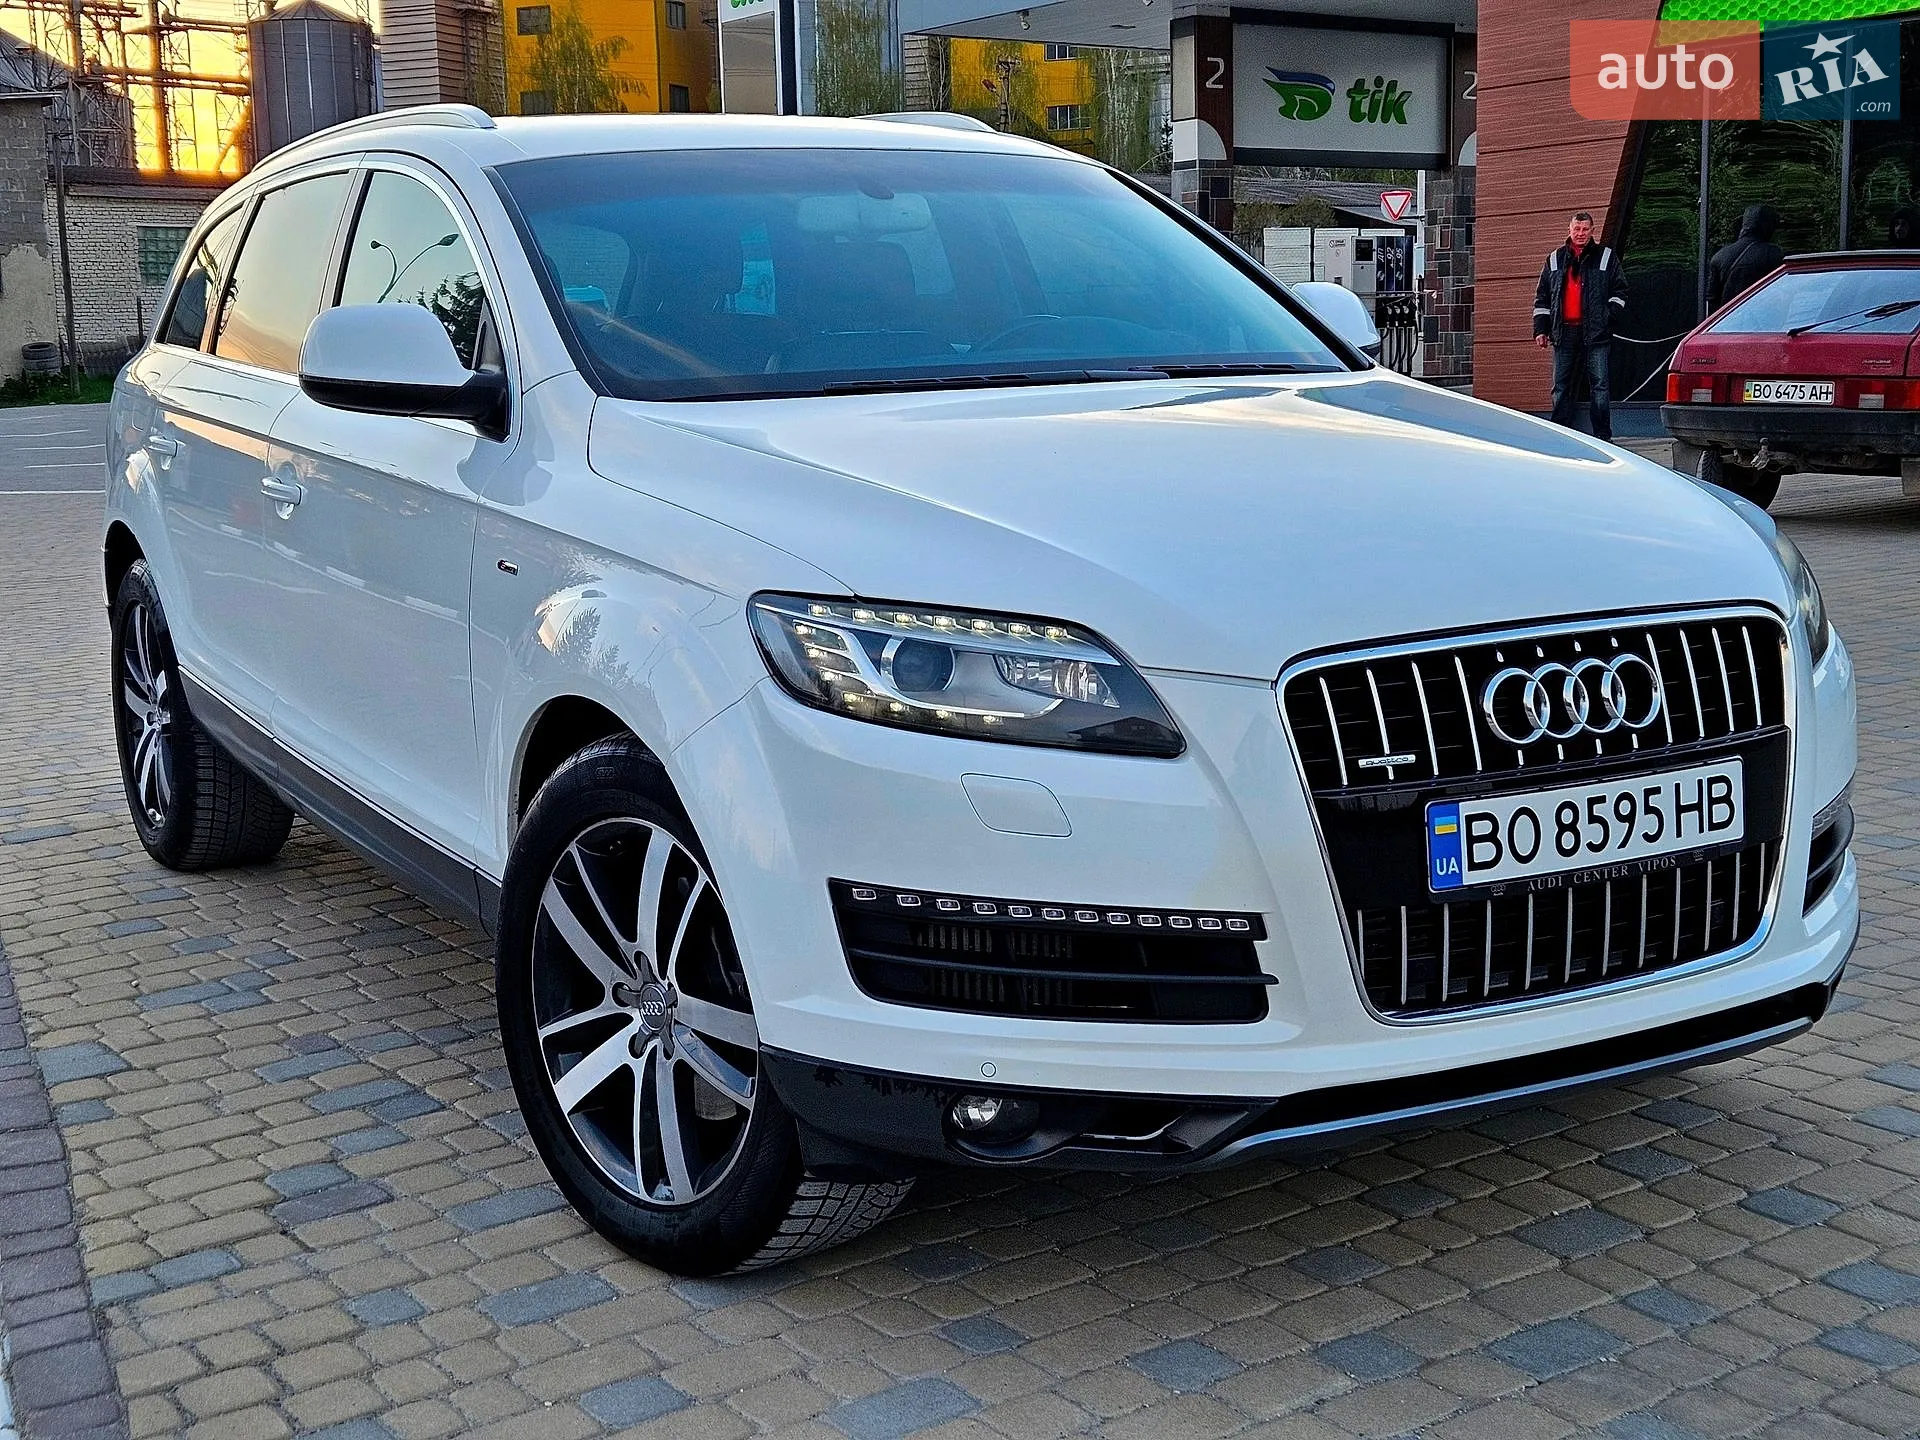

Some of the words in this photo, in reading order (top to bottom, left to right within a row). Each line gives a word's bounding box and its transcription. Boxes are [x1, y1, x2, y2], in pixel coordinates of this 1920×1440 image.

[1205, 57, 1225, 89] 2
[1462, 71, 1478, 100] 2
[1752, 384, 1771, 399] BO
[1774, 384, 1806, 400] 6475
[1808, 386, 1830, 400] AH
[1464, 806, 1542, 872] BO
[1554, 786, 1665, 858] 8595
[1673, 774, 1736, 839] HB
[1436, 860, 1460, 876] UA
[1527, 875, 1563, 892] AUDI
[1573, 864, 1629, 884] CENTER
[1638, 856, 1677, 873] VIPOS
